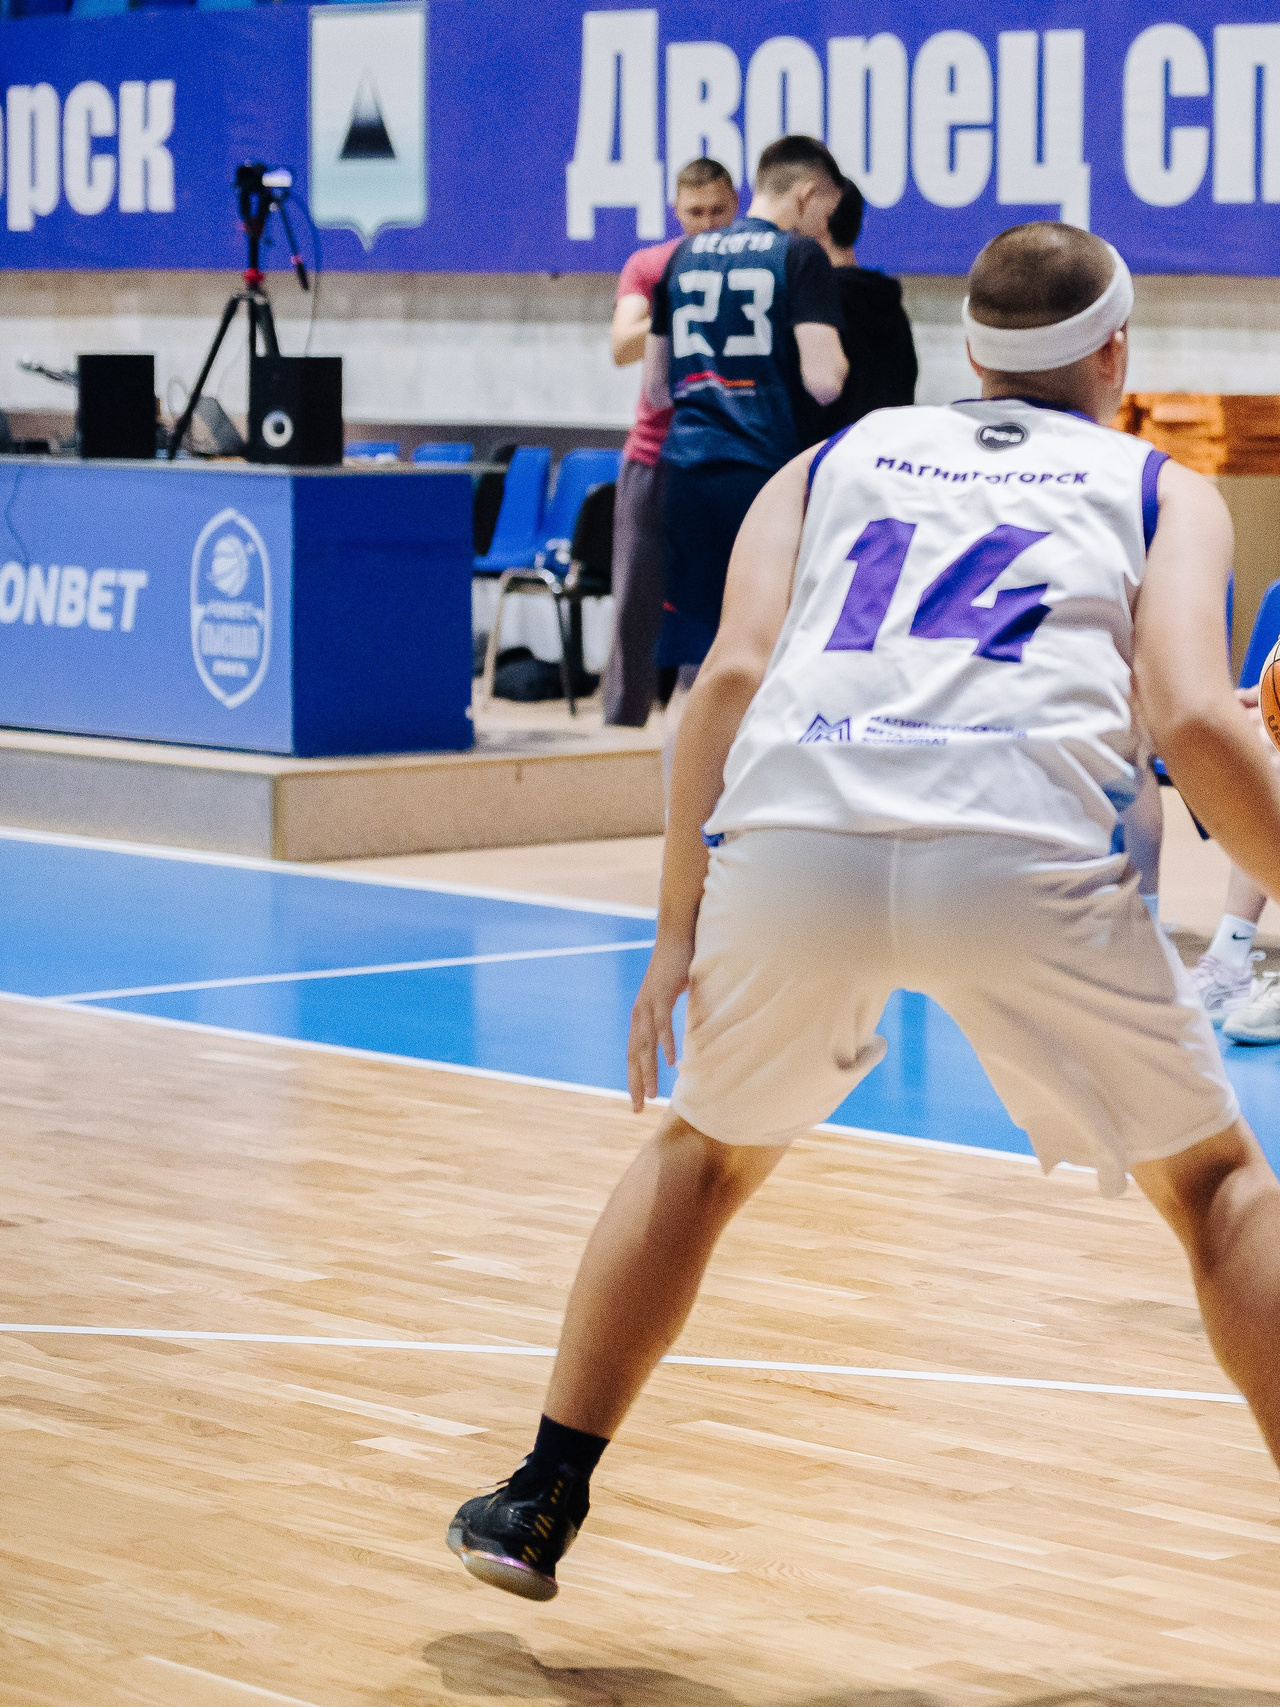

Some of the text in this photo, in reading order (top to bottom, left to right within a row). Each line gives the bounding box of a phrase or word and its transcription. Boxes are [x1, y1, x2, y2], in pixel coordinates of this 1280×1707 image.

[0, 79, 176, 231] рск
[566, 8, 1091, 240] Дворец
[672, 268, 775, 358] 23
[873, 456, 1091, 485] МАГНИТОГОРСК
[822, 517, 1053, 663] 14
